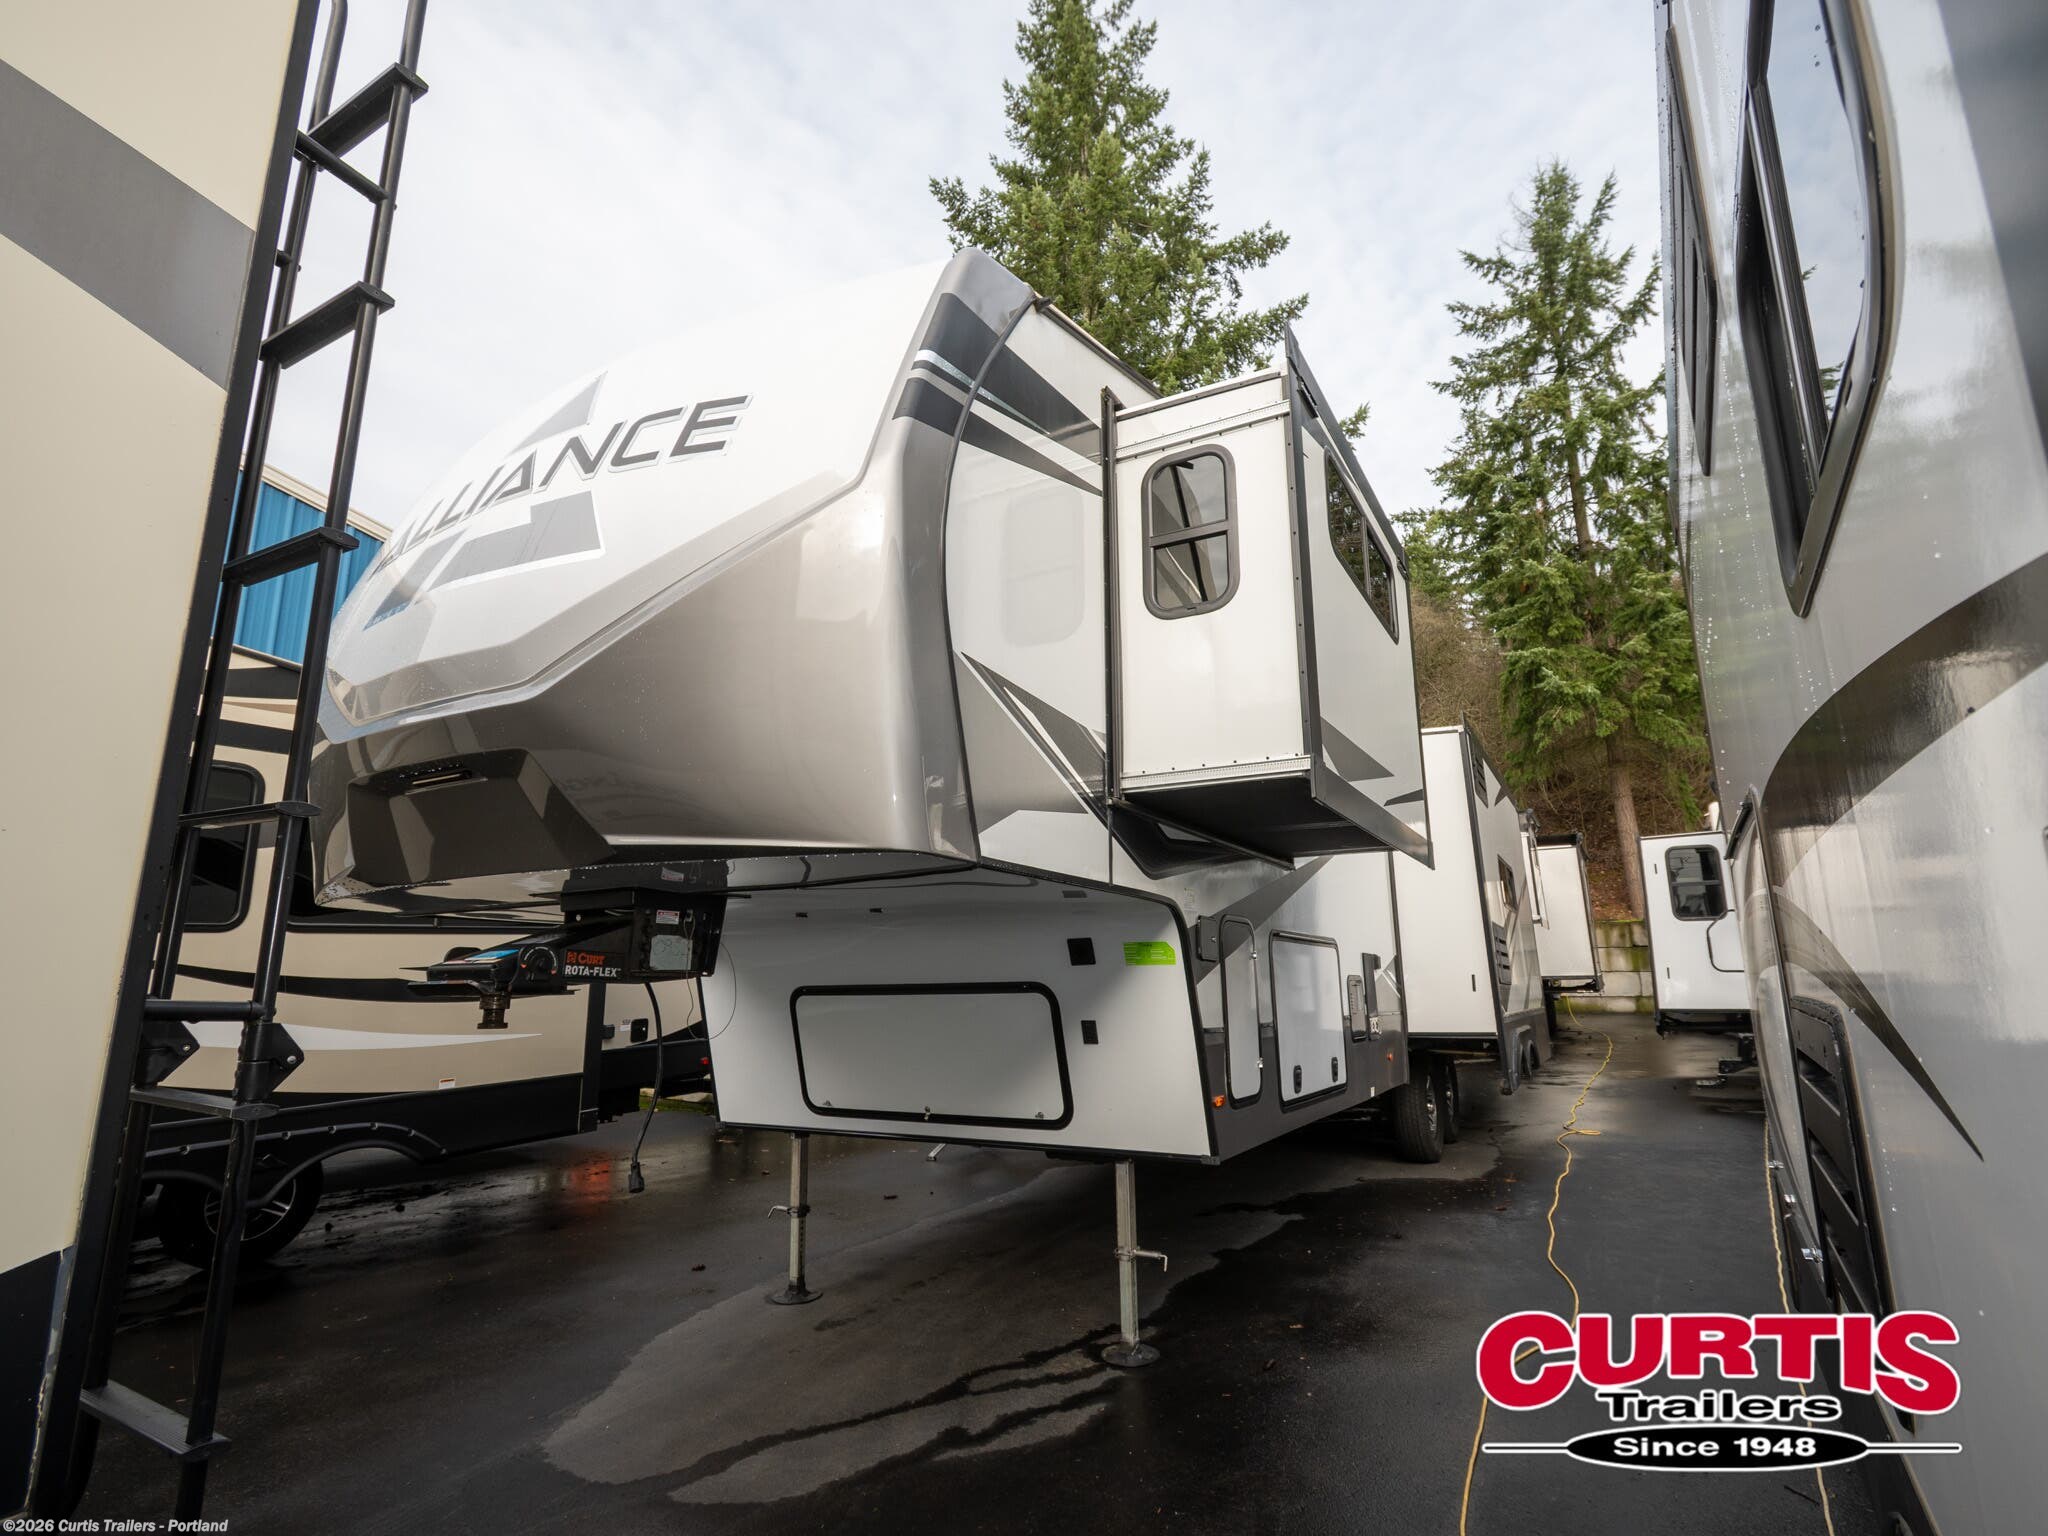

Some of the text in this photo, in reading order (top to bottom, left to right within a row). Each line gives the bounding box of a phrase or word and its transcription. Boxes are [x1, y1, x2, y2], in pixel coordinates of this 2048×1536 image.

[368, 394, 750, 582] ALLIANCE
[577, 952, 606, 965] CURT
[564, 964, 618, 977] ROTA-FLEX
